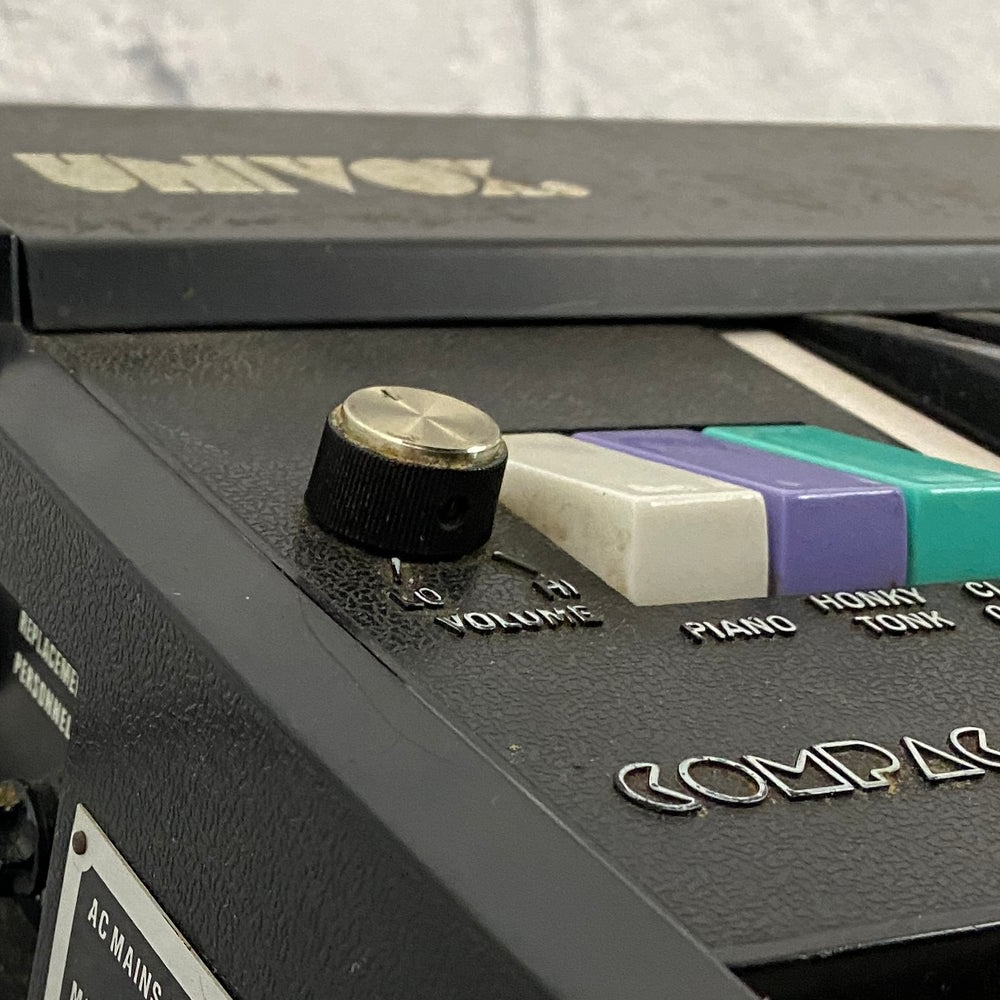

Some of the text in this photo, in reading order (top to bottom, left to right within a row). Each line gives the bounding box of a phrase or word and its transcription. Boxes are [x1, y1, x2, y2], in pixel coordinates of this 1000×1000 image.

[389, 586, 444, 611] LO
[535, 578, 580, 601] HI
[808, 586, 927, 613] HONKY
[434, 604, 603, 636] VOLUME
[682, 614, 797, 643] PIANO
[854, 610, 956, 638] TONK
[12, 651, 72, 740] PERSONNEL
[87, 897, 110, 941] AC
